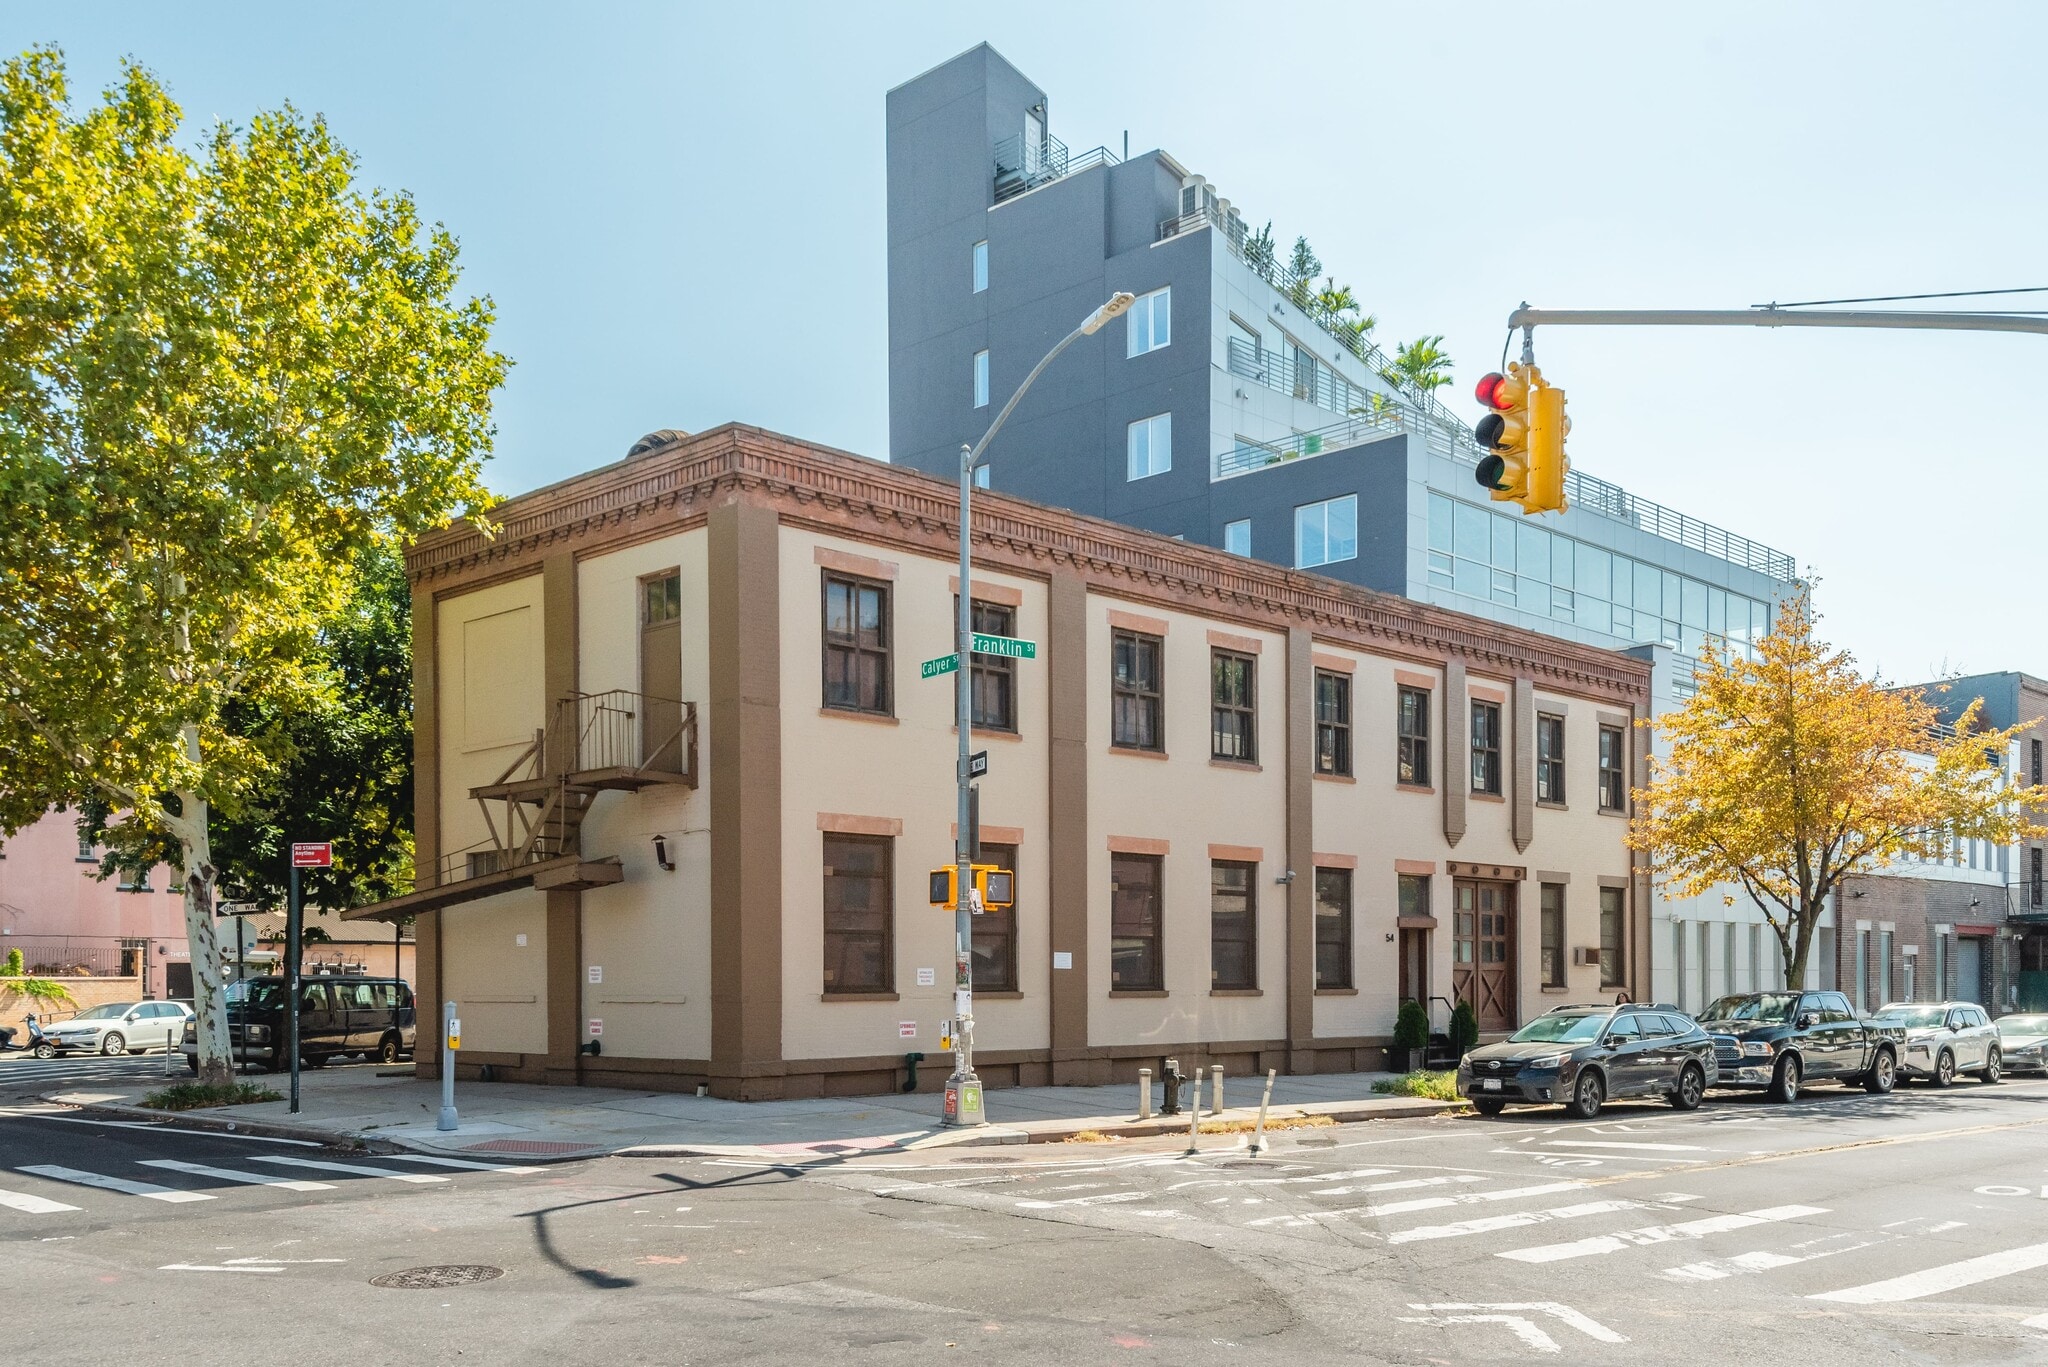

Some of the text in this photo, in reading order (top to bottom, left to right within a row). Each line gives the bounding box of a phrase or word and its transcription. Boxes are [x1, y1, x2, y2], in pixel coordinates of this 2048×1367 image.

[972, 636, 1034, 656] Franklin St
[922, 658, 950, 675] Calyer
[1386, 934, 1394, 942] 54
